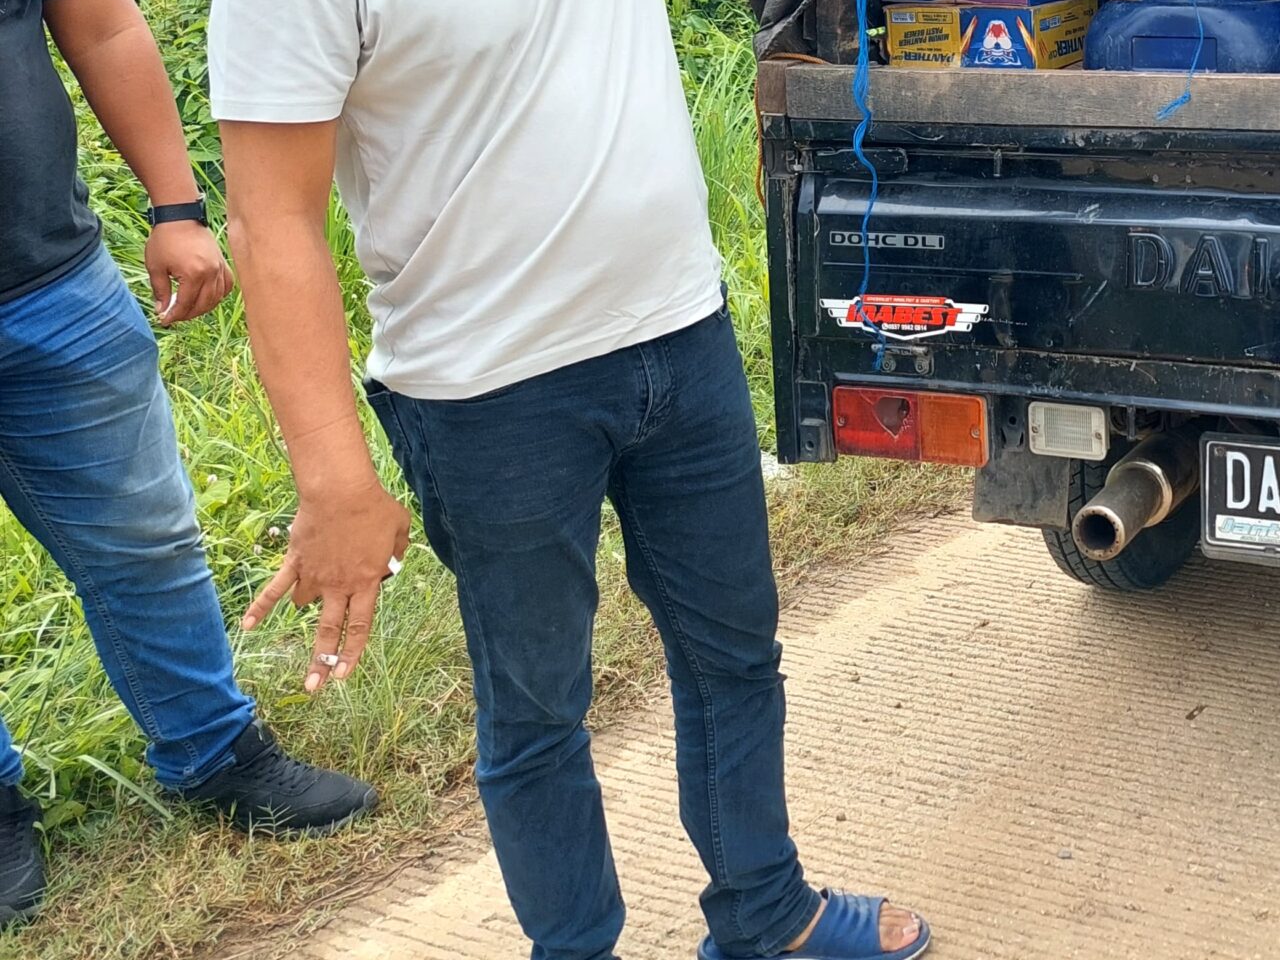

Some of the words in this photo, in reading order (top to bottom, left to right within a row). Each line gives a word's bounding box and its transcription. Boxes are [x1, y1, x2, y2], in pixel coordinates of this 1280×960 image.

[925, 26, 944, 36] PASTI
[1056, 35, 1085, 57] NTHER
[902, 52, 955, 63] PANTHER
[830, 232, 897, 247] DOHC
